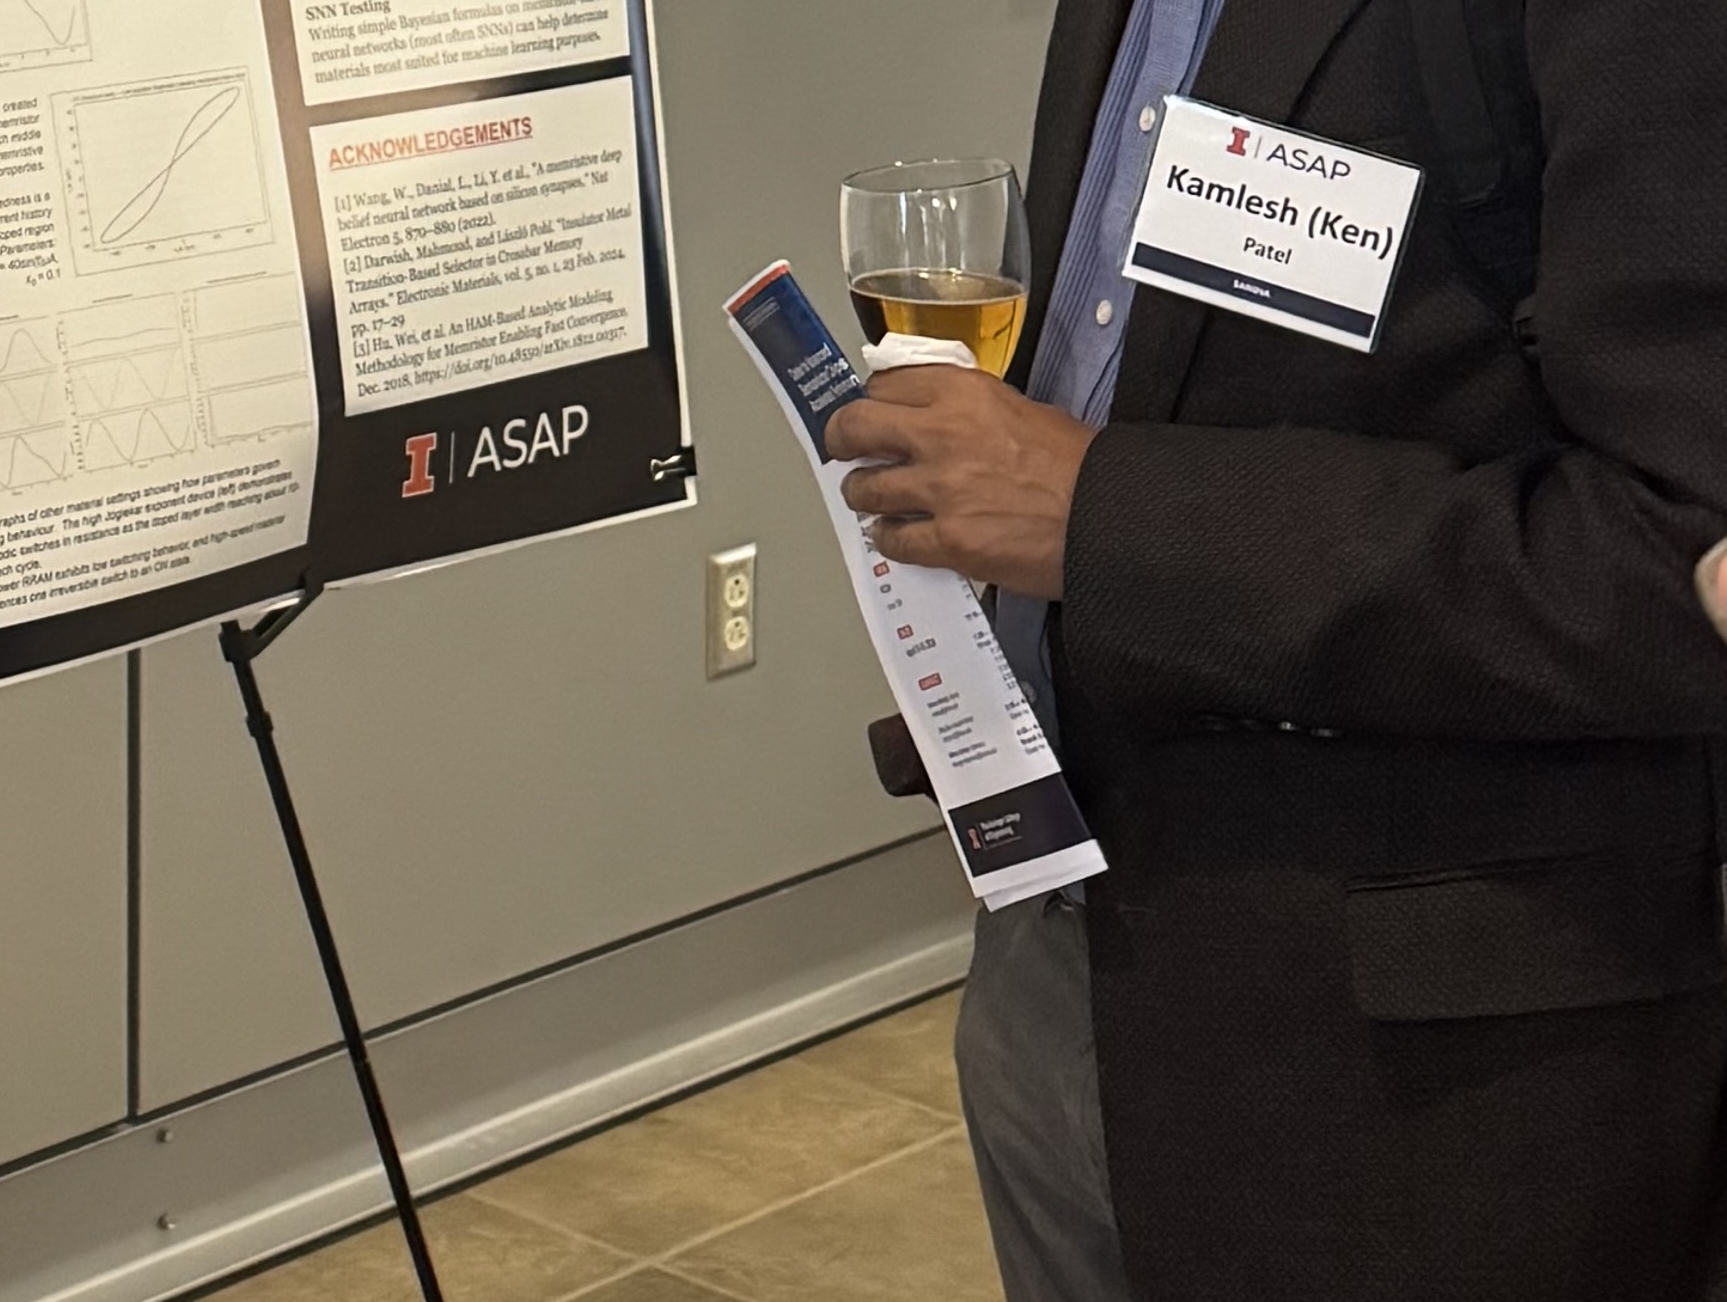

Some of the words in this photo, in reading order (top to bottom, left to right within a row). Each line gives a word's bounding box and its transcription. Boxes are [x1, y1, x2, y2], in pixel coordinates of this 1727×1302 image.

[305, 3, 337, 21] SNN
[339, 0, 391, 15] Testing
[329, 116, 533, 167] ACKNOWLEDGEMENTS
[1266, 143, 1351, 181] ASAP
[1166, 164, 1299, 227] Kamlesh
[1307, 205, 1394, 261] (Ken)
[1243, 236, 1293, 265] Patel
[467, 404, 589, 478] ASAP
